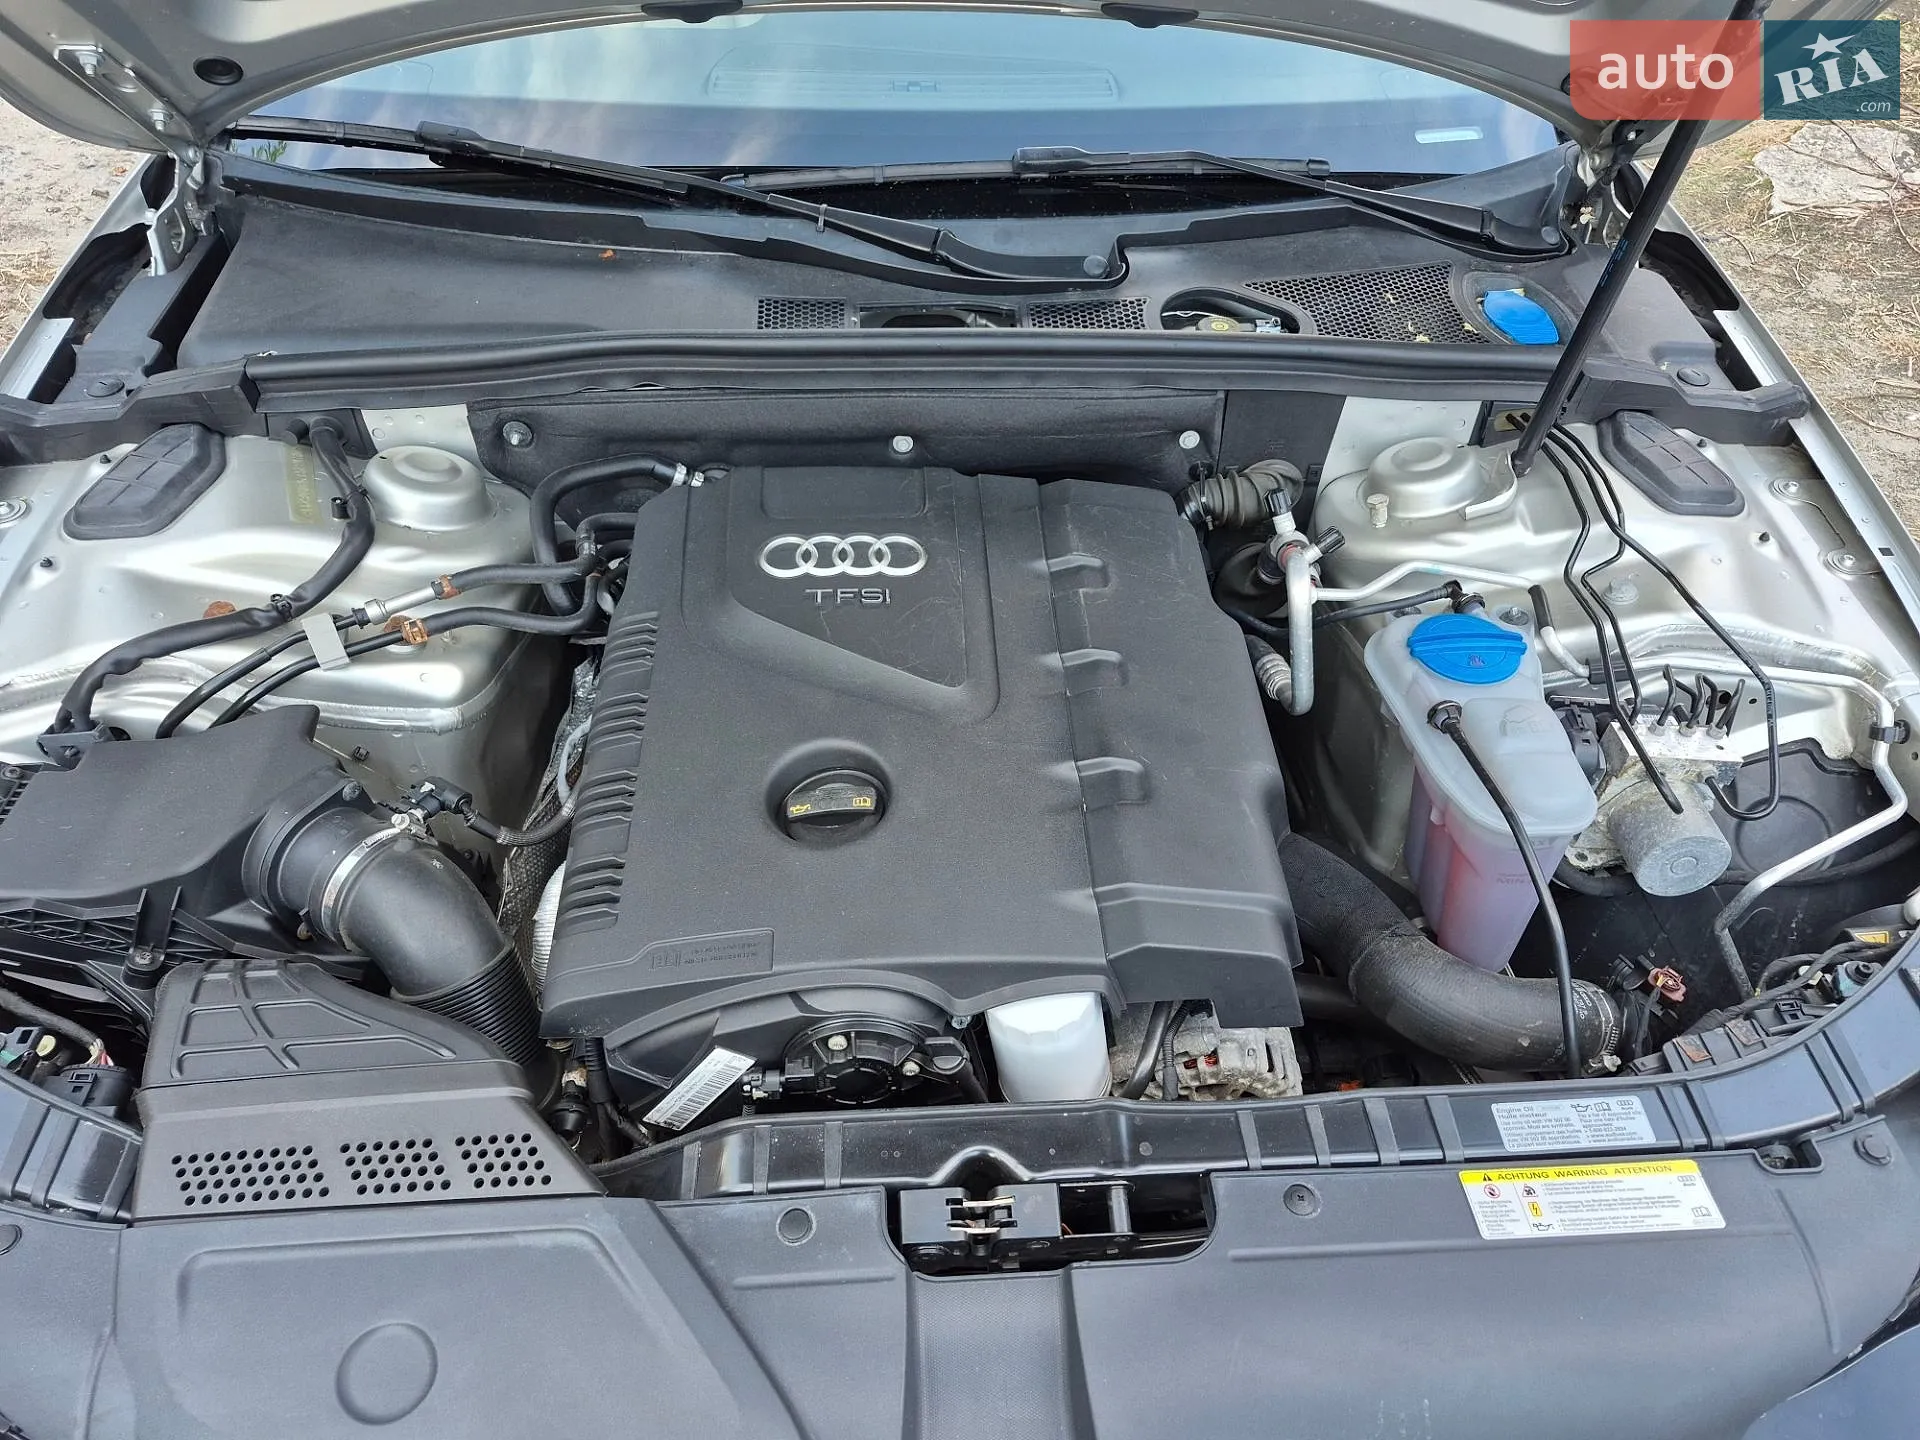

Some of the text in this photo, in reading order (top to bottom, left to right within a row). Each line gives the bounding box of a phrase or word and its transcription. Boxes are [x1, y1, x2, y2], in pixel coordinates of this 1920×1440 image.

[805, 588, 891, 605] TFSI
[1498, 1164, 1672, 1181] ACHTUNG WARNING ATTENTION
